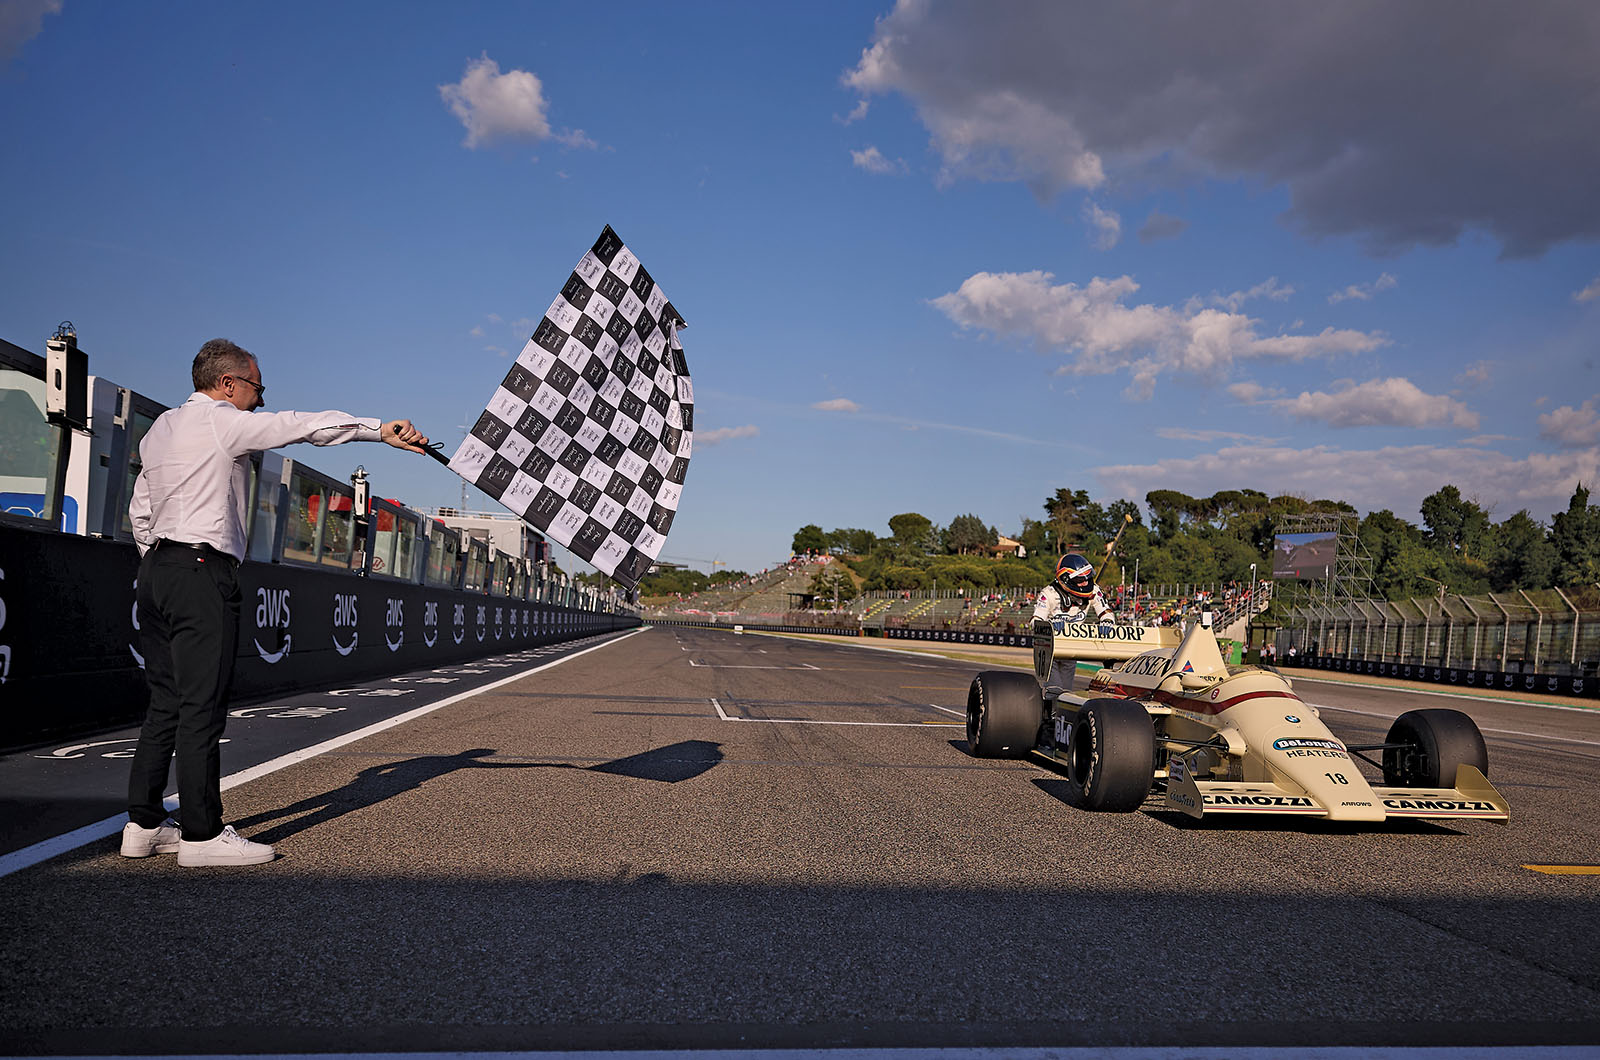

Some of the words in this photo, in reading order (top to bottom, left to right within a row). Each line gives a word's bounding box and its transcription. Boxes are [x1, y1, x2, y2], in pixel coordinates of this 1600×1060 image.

[514, 373, 524, 386] Lopez
[565, 447, 577, 462] Smith
[257, 587, 290, 628] aws
[334, 594, 357, 627] aws
[386, 598, 403, 627] aws
[424, 602, 438, 626] aws
[454, 604, 464, 625] aws
[1278, 739, 1342, 750] DeLonghi
[1286, 750, 1348, 760] HEATERS
[1325, 773, 1349, 785] 18
[1203, 796, 1313, 806] CAMOZZI
[1383, 800, 1496, 811] CAMOZZI
